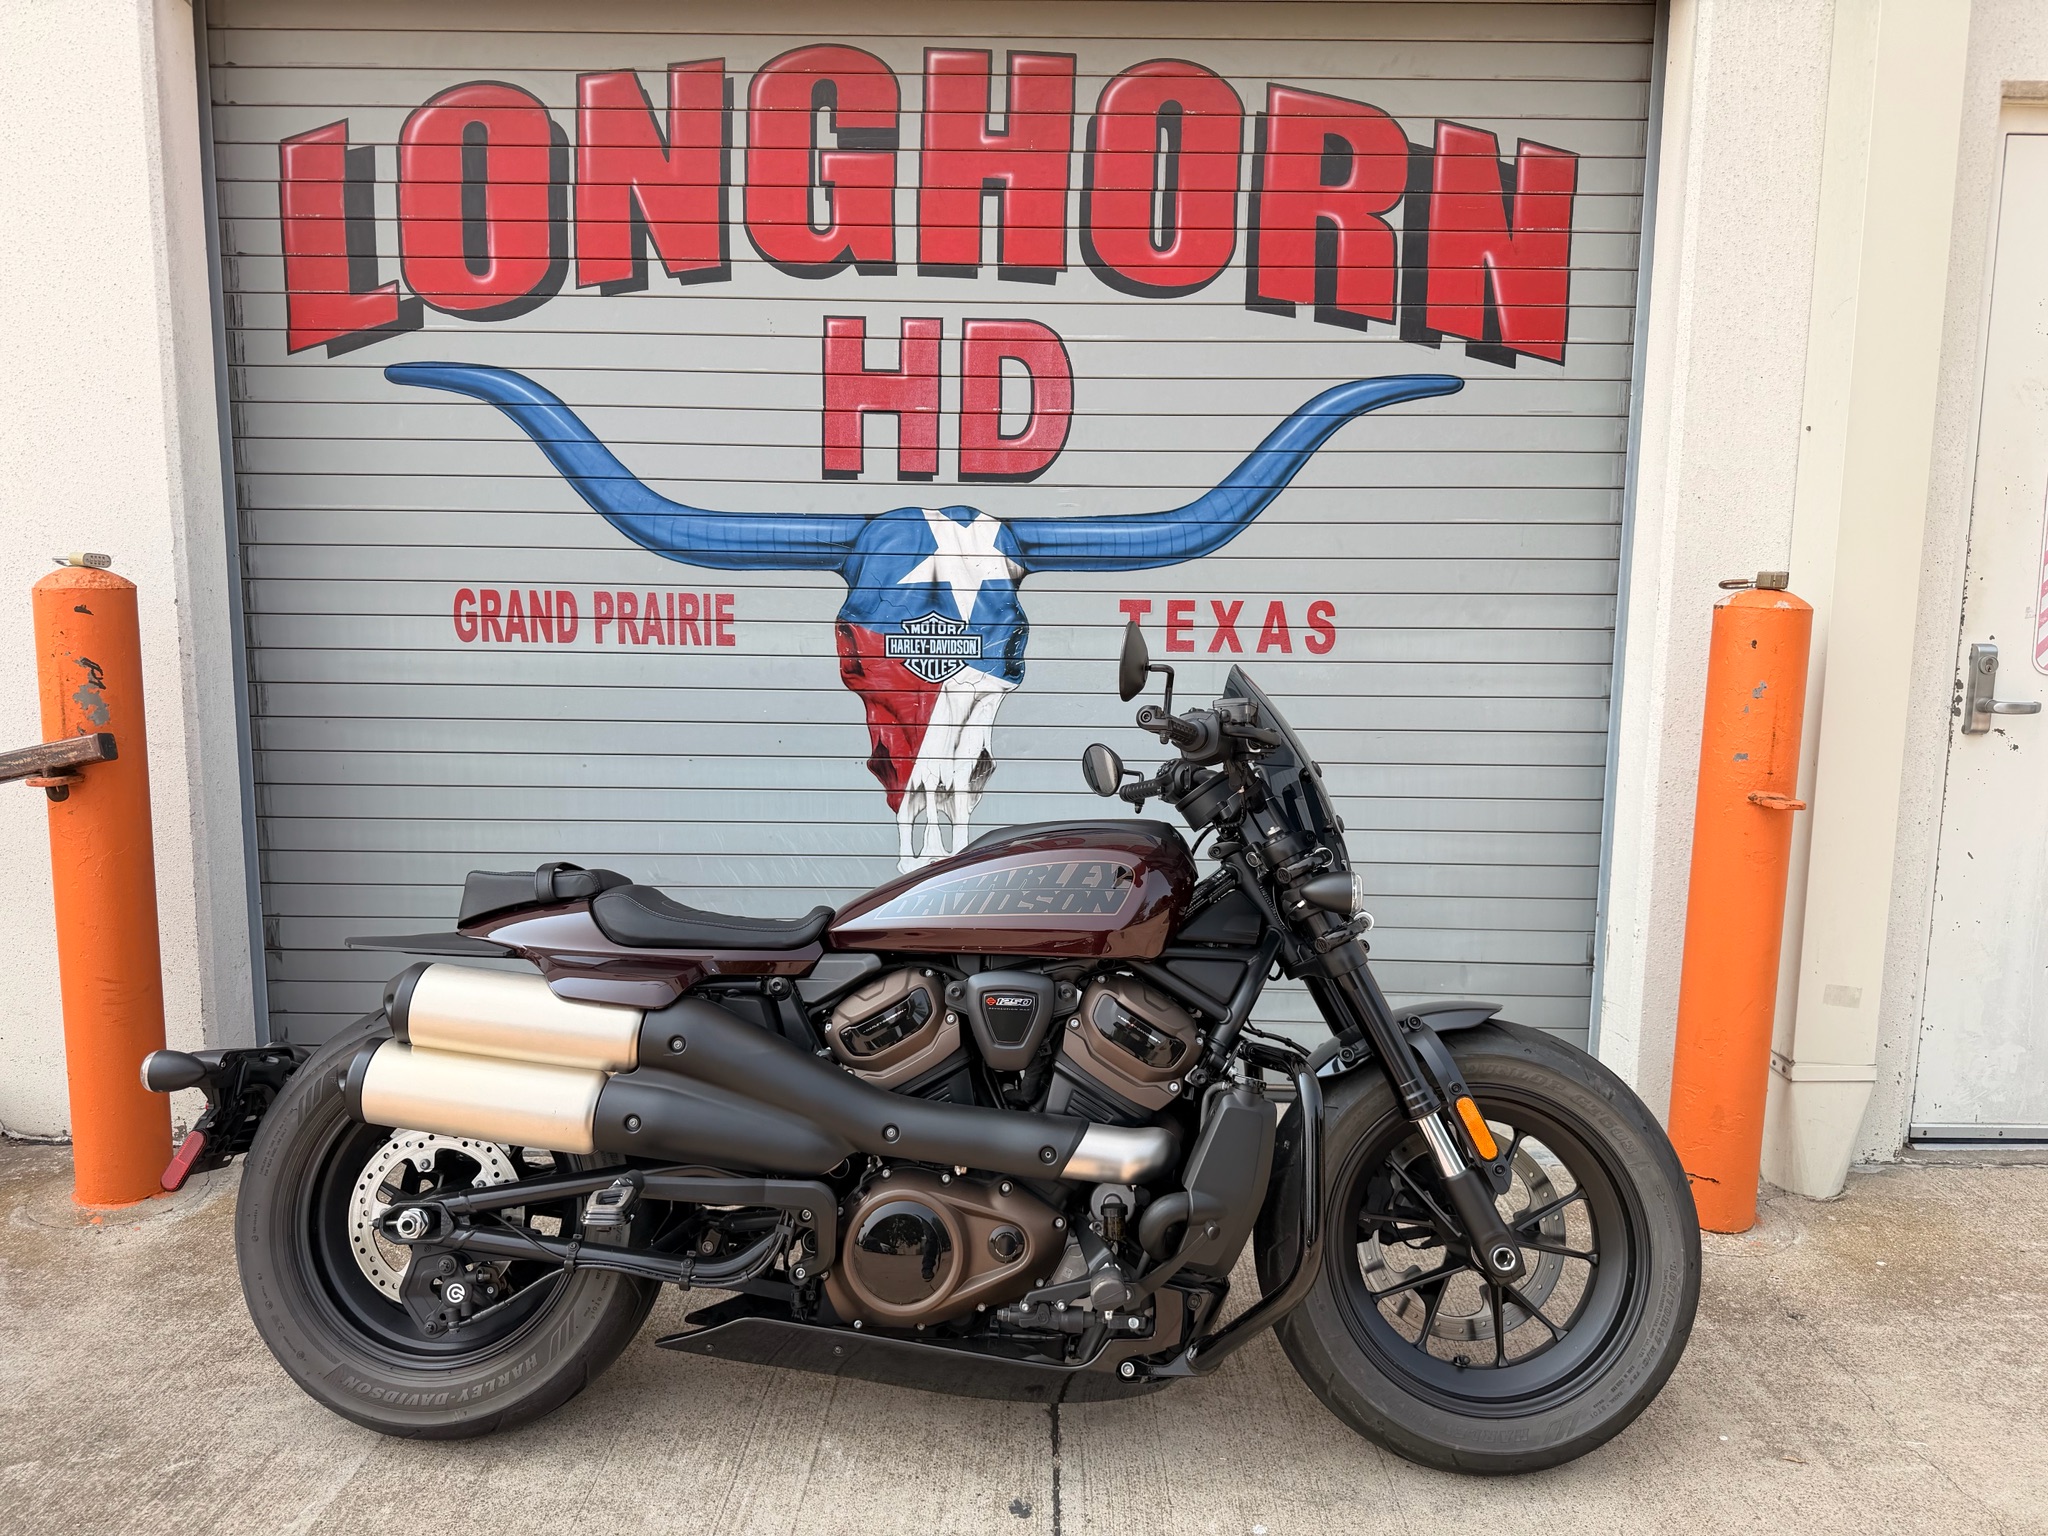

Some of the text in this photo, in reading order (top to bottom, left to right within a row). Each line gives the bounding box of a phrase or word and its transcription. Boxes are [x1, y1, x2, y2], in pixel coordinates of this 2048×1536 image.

[279, 43, 1579, 366] LONGHORN
[822, 316, 1074, 481] HD
[453, 588, 736, 647] GRAND PRAIRIE
[911, 618, 957, 635] MOTOR
[1119, 599, 1337, 655] TEXAS
[890, 638, 978, 655] HARLEY-DAVIDSON
[911, 659, 957, 680] CYCLES
[880, 890, 1129, 916] DAVIDSON
